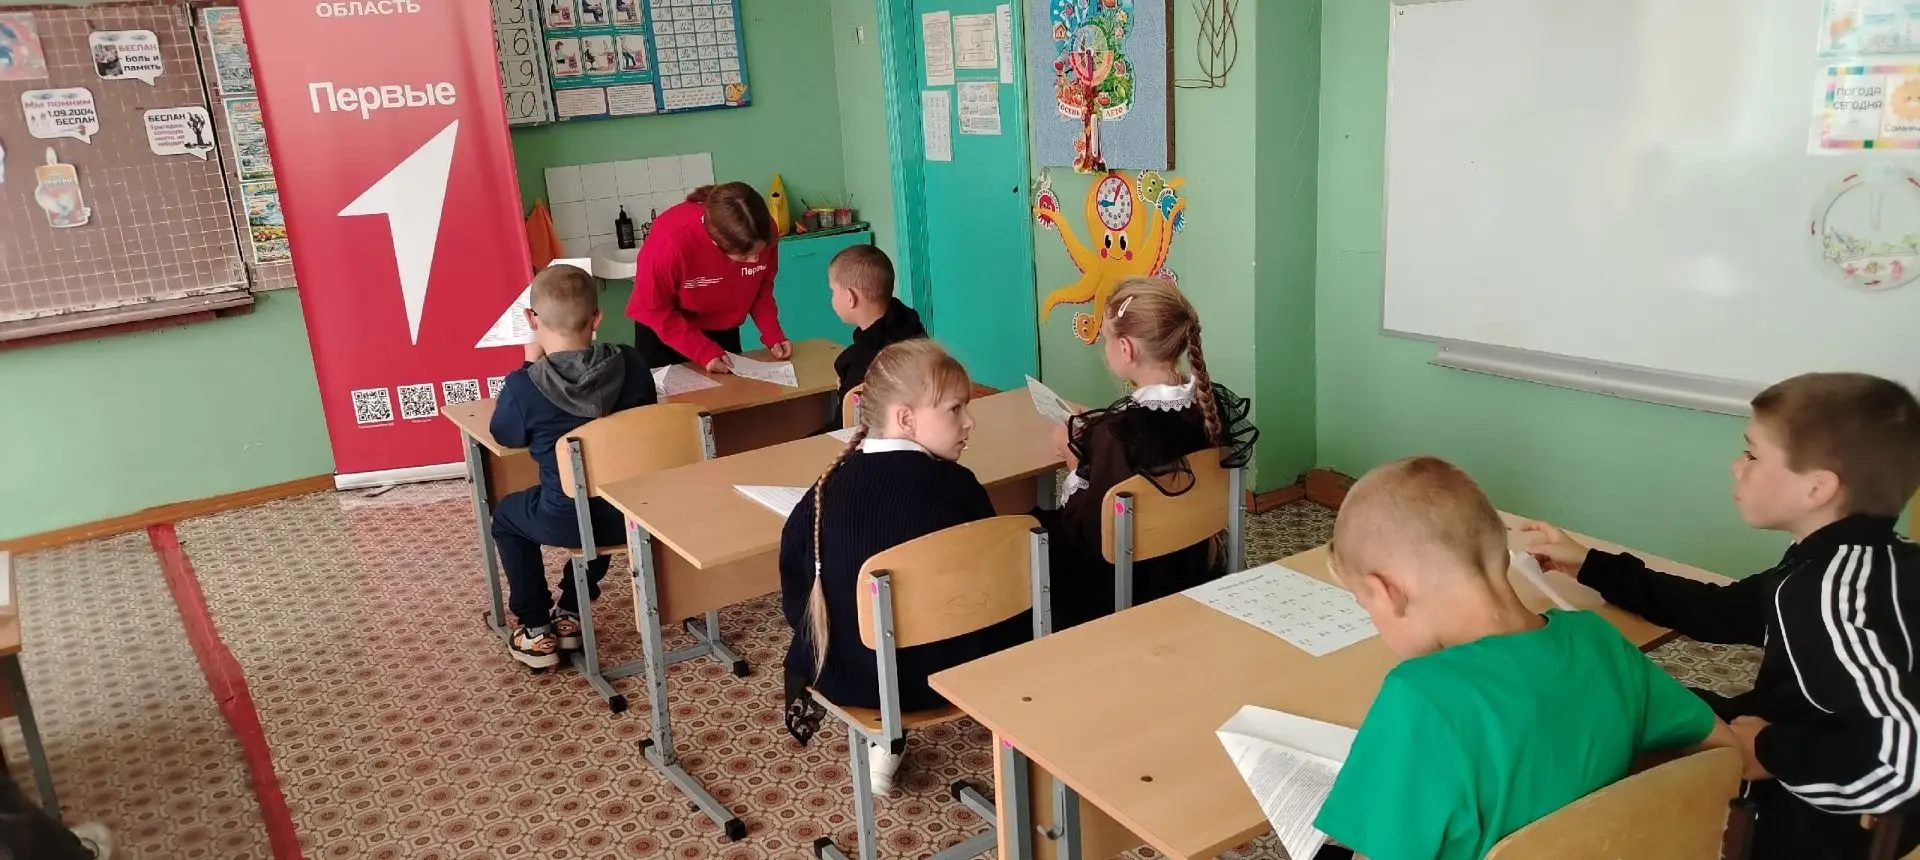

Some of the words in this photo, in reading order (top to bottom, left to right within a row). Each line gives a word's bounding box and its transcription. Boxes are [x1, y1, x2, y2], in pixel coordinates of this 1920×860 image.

[315, 0, 421, 18] ОБЛАСТЬ
[513, 28, 529, 55] 6
[118, 43, 157, 52] БЕСЛАН
[519, 60, 534, 86] 9
[1836, 87, 1882, 97] ПОГОДА
[308, 82, 457, 120] Первые
[1833, 100, 1882, 111] СЕГОДНЯ
[55, 117, 96, 126] БЕСЛАН
[148, 113, 186, 123] БЕСЛАН
